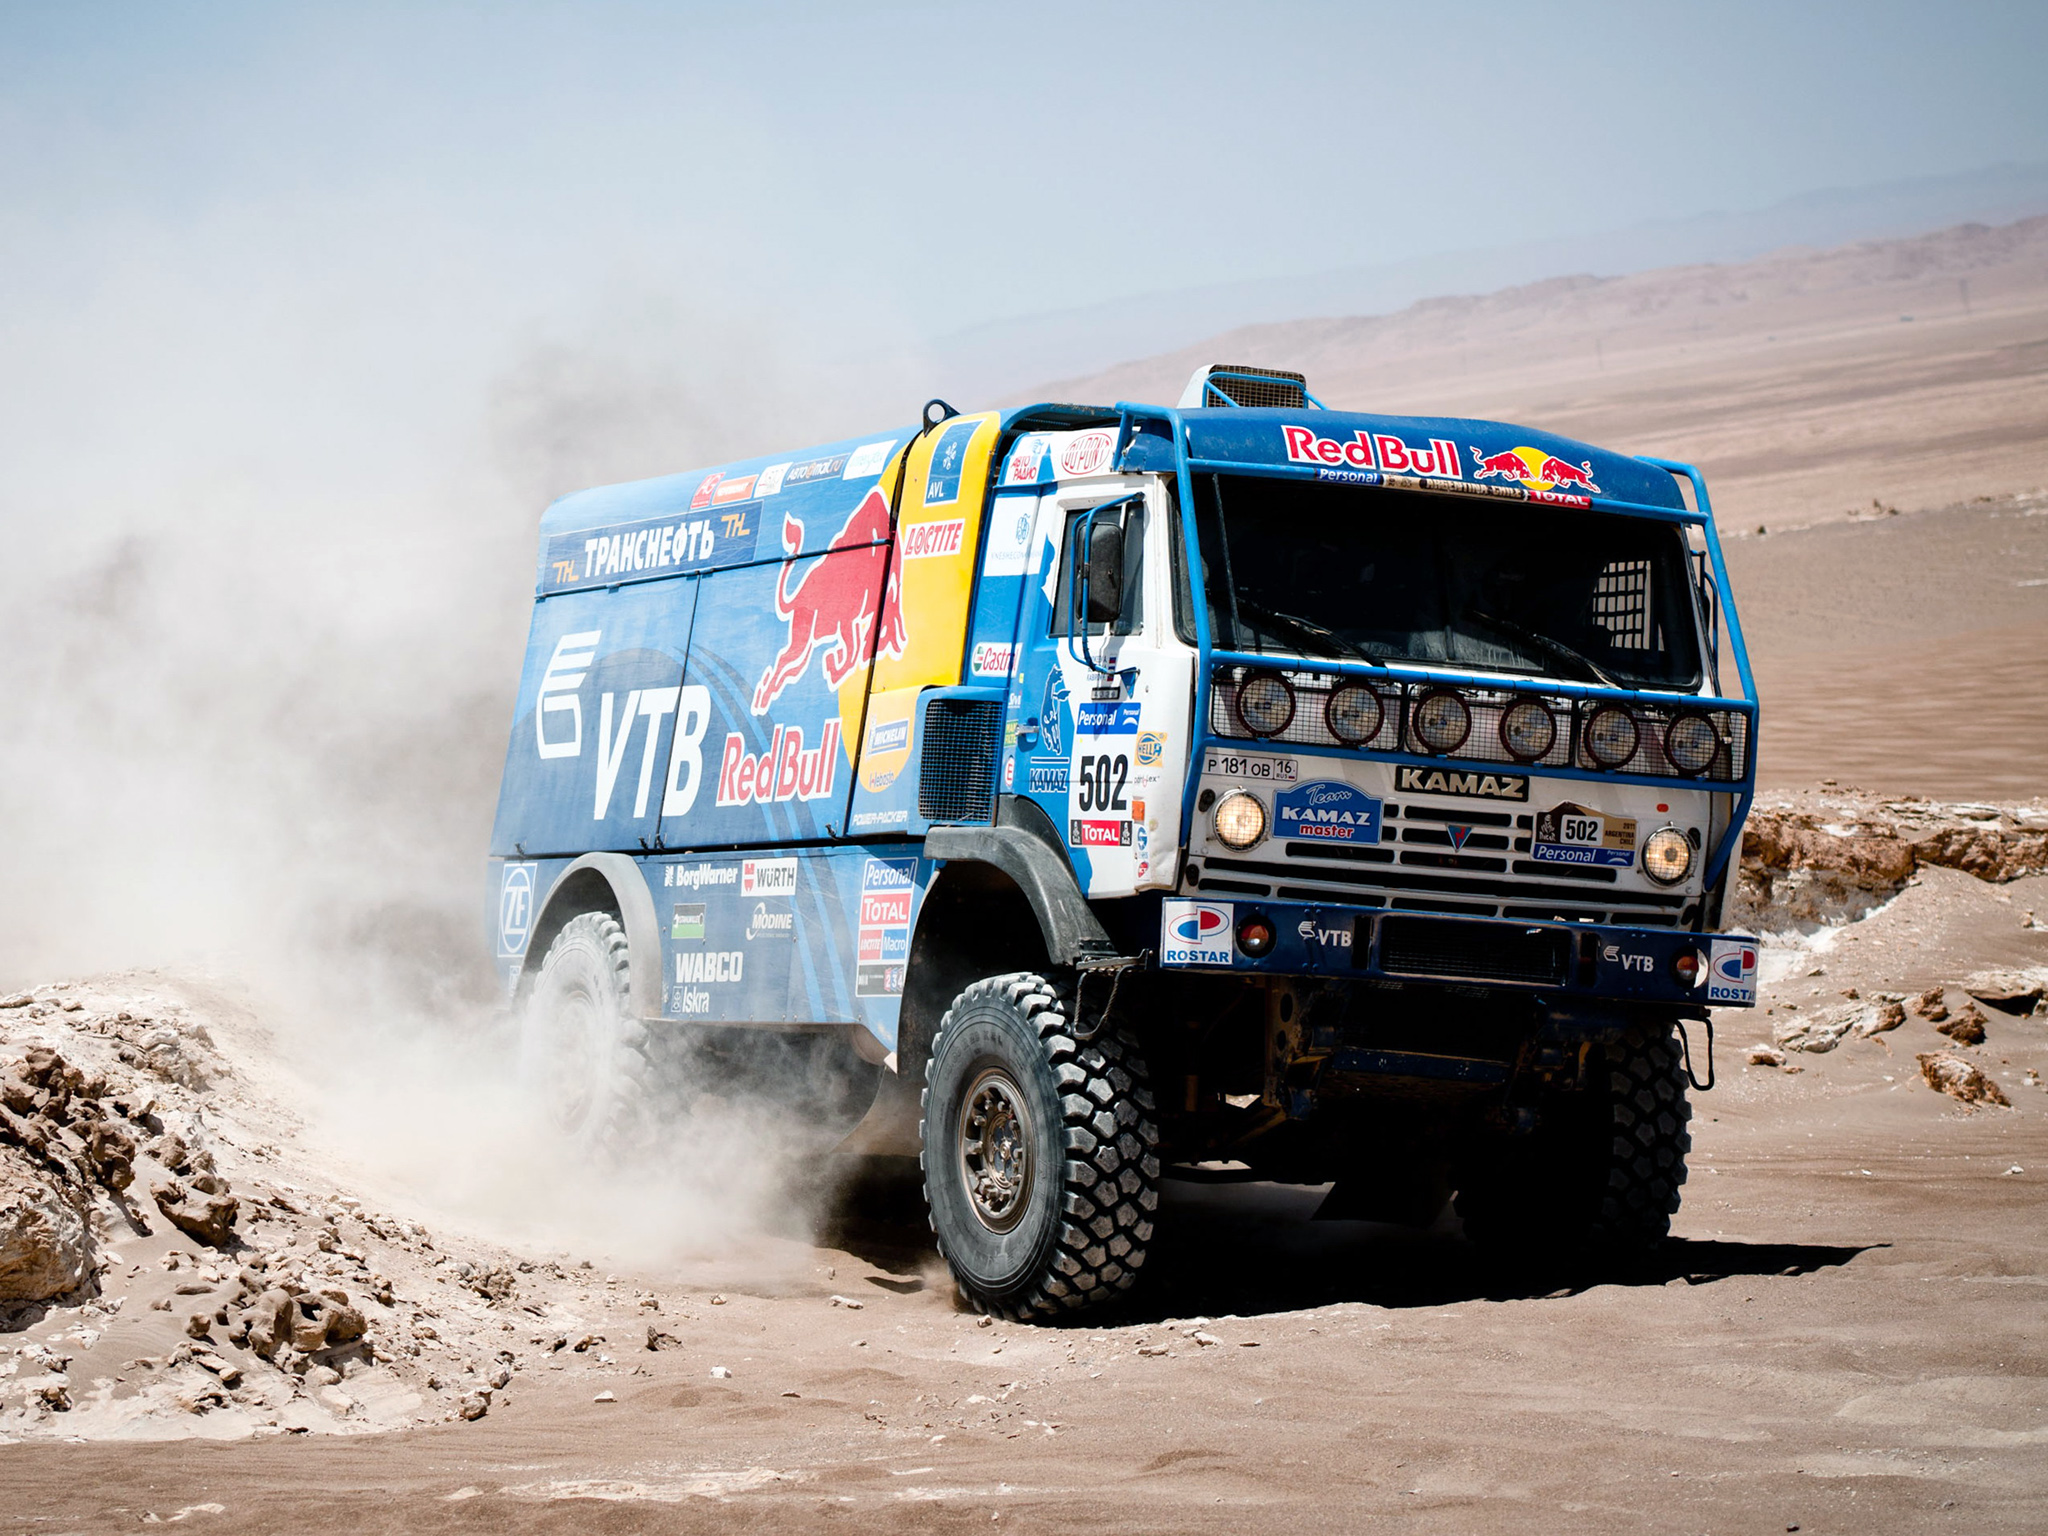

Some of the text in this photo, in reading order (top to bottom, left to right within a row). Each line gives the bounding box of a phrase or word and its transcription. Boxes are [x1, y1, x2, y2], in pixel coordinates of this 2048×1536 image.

[1281, 425, 1463, 480] Red Bull
[927, 482, 944, 499] AVL
[1319, 468, 1378, 483] Personal
[1534, 490, 1589, 507] TOTAL
[584, 519, 715, 578] ТРАНСНЕФТЬ
[905, 522, 963, 555] LOCTITE
[1078, 709, 1117, 726] Personal
[874, 726, 907, 746] MICHELIN
[593, 684, 712, 820] VTB
[1138, 743, 1162, 757] HELLA
[715, 717, 841, 807] Red Bull
[1221, 757, 1247, 775] 181
[1276, 761, 1292, 774] 16
[1029, 768, 1068, 793] KAMAZ
[1079, 754, 1128, 811] 502
[1401, 768, 1524, 798] KAMAZ
[1305, 784, 1352, 805] Team
[1281, 806, 1370, 826] KAMAZ
[1082, 824, 1119, 841] TOTAL
[1299, 824, 1355, 839] master
[1565, 819, 1598, 842] 502
[1605, 830, 1635, 839] ARGENTINA
[1620, 838, 1634, 846] CHILE
[1537, 845, 1597, 863] Personal
[676, 863, 738, 891] BorgWarner
[866, 861, 915, 887] Personal
[505, 886, 530, 935] ZF
[864, 897, 908, 922] TOTAL
[752, 913, 793, 930] MODINE
[883, 936, 905, 952] Macro
[1318, 928, 1352, 948] VTB
[1167, 949, 1229, 963] ROSTAR
[1621, 953, 1654, 973] VTB
[676, 951, 744, 983] WABCO
[682, 985, 710, 1014] Iskra
